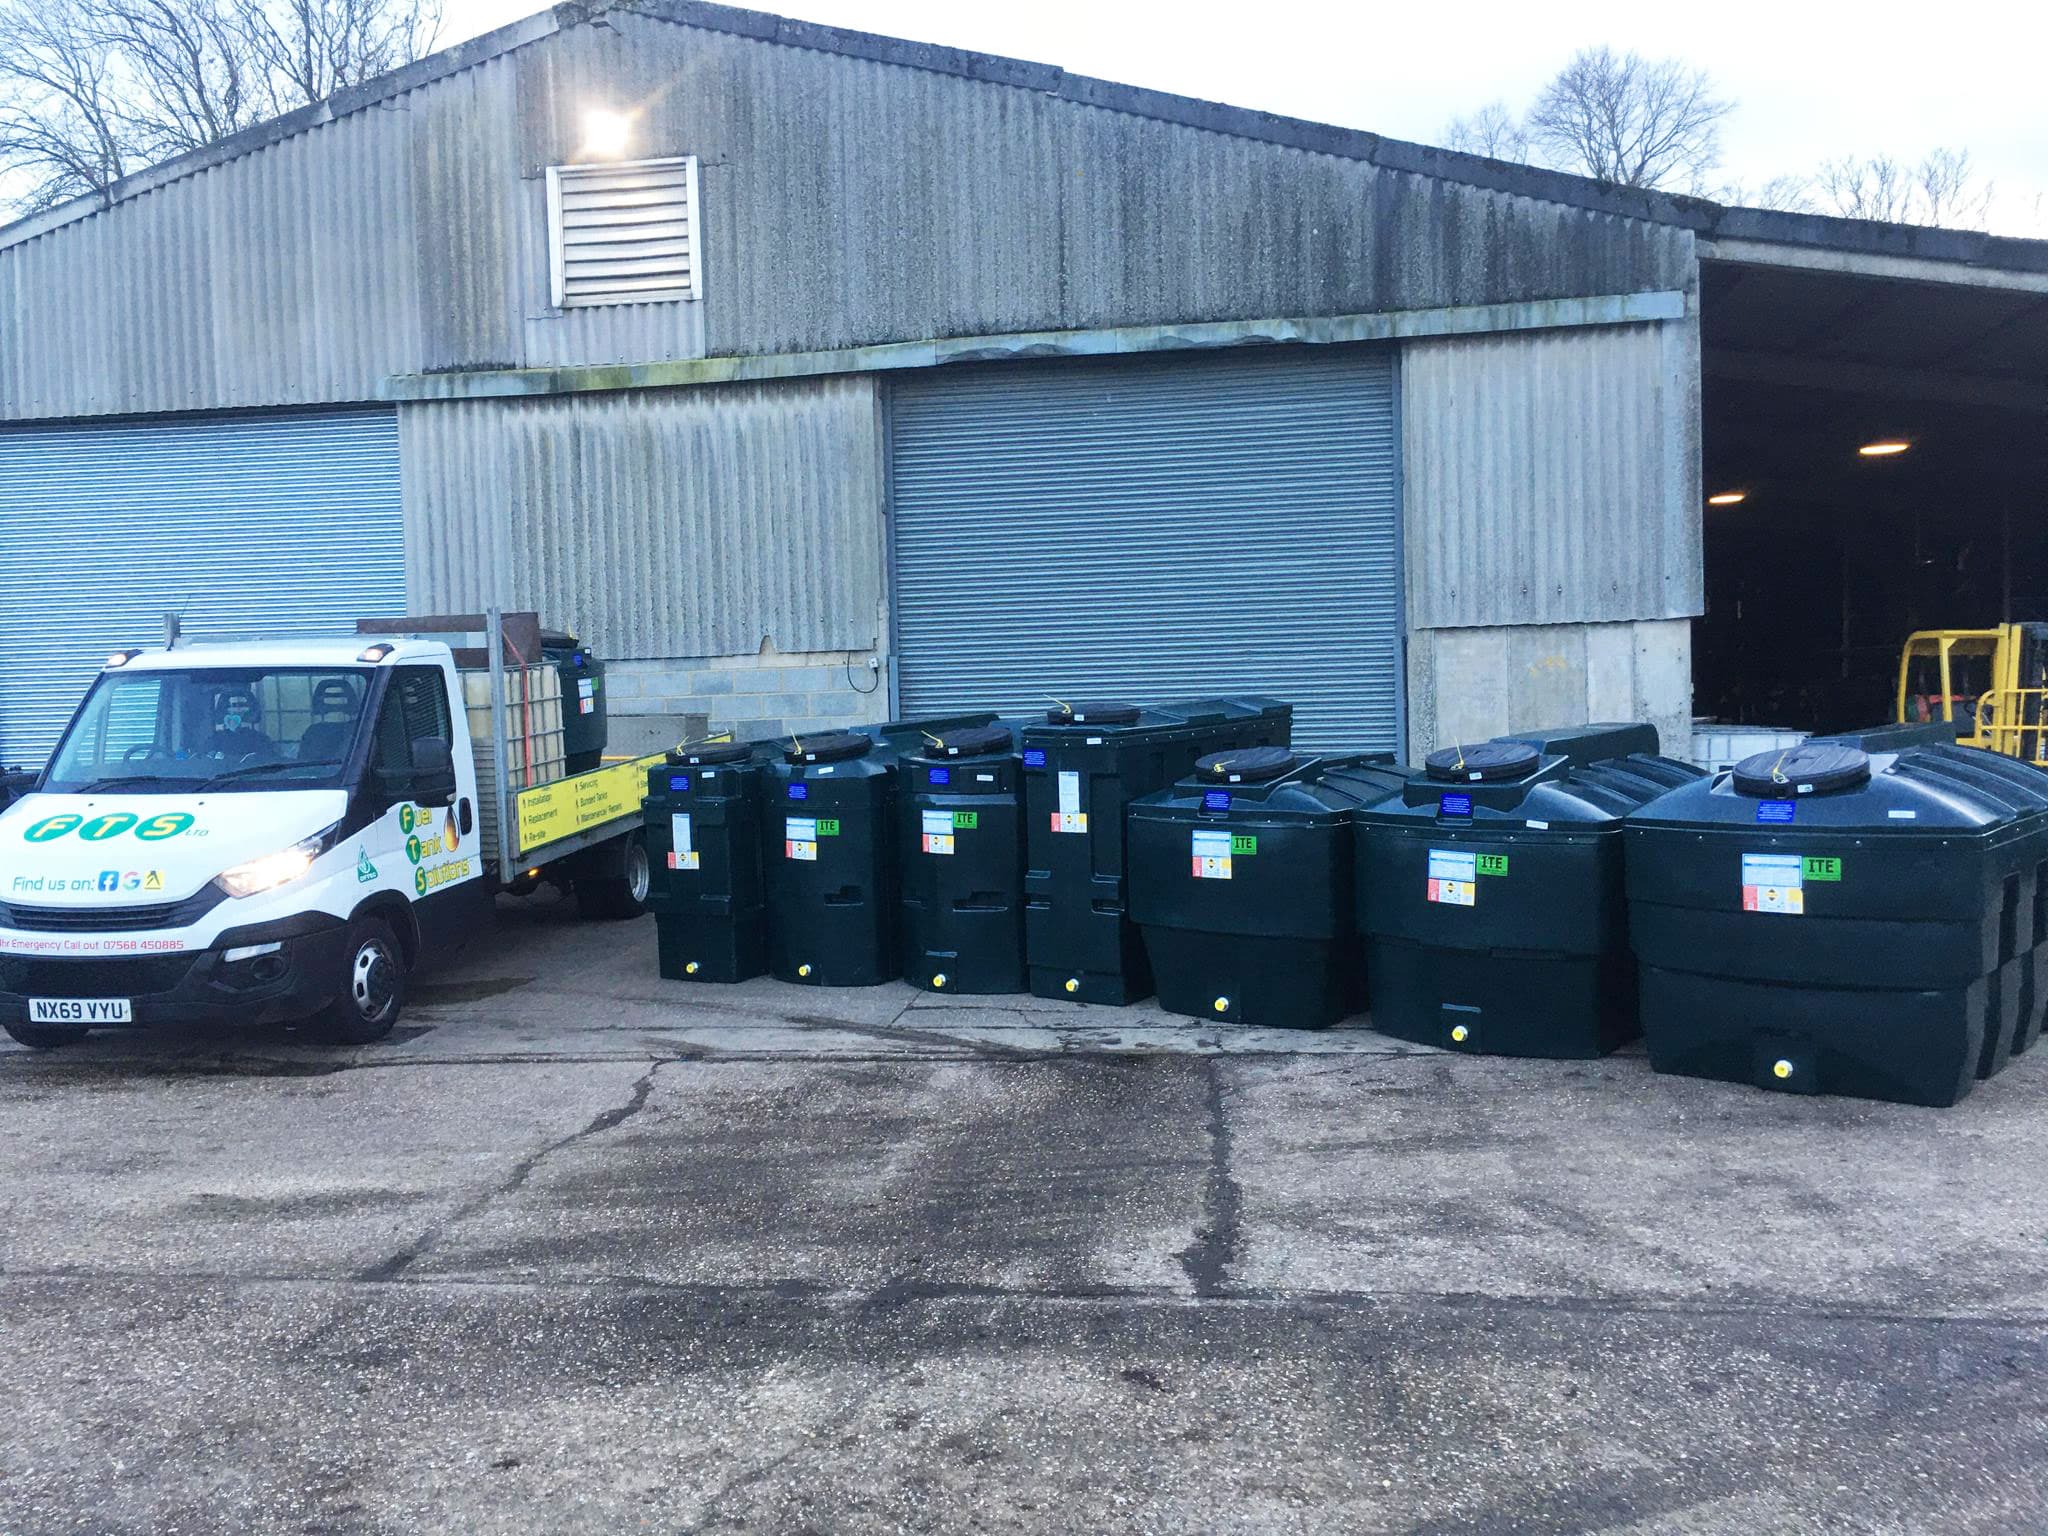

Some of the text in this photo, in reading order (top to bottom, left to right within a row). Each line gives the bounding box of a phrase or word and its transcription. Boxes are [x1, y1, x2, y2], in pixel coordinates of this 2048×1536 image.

[401, 806, 433, 830] Fuel
[528, 808, 557, 824] Replacement
[956, 813, 973, 824] ITE
[819, 820, 835, 831] ITE
[409, 831, 443, 860] Tank
[1234, 837, 1253, 849] ITE
[1480, 855, 1503, 870] ITE
[1808, 858, 1834, 873] ITE
[416, 857, 470, 891] Solutions
[12, 875, 44, 891] Find
[48, 878, 66, 891] us
[71, 878, 96, 891] on:
[11, 939, 61, 951] Emergency
[64, 939, 81, 950] Call
[83, 941, 99, 950] out
[103, 940, 137, 950] 07568
[140, 940, 184, 950] 450885
[36, 1001, 123, 1019] NX69 VYU
